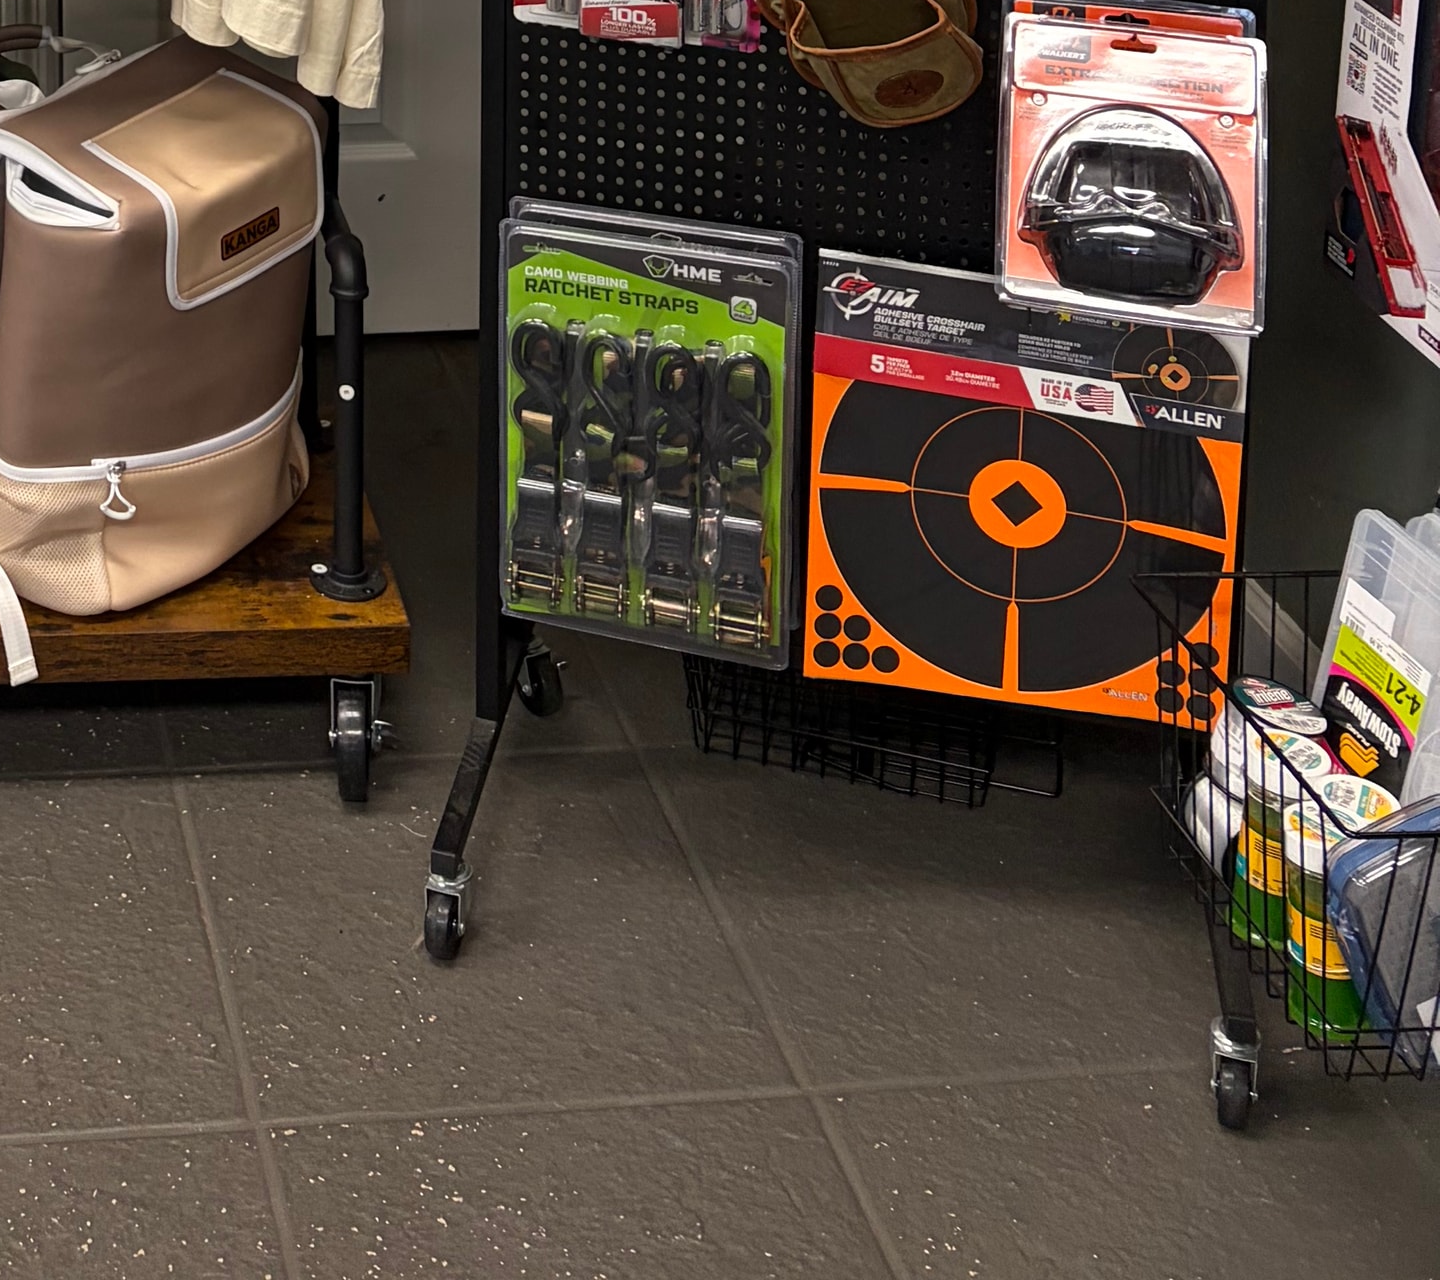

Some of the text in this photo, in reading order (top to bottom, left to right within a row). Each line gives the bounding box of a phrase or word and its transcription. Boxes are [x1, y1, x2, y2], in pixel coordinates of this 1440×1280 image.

[601, 19, 627, 27] LONGER
[609, 8, 656, 26] 100%
[1375, 11, 1397, 37] CLEANING
[1039, 48, 1086, 59] WALKER'S
[1352, 23, 1401, 71] ALL IN ONE.
[223, 213, 278, 255] KANGA
[525, 266, 628, 289] CAMO WEBBING
[673, 264, 721, 282] HME
[525, 278, 698, 314] RATCHET STRAPS
[839, 278, 920, 309] EZ AIM
[733, 300, 754, 315] 4
[873, 315, 965, 336] BULLSEYE TARGET
[874, 307, 986, 332] ADHESIVE CROSSHAIR
[1072, 315, 1107, 325] TECHNOLOGY
[873, 323, 973, 345] CIBLE ADHESIVE DE TYPE
[892, 333, 903, 341] DE
[905, 334, 932, 344] BOEUF
[870, 354, 884, 373] 5
[1040, 383, 1073, 401] USA
[1153, 406, 1222, 430] ALLEN
[1107, 689, 1148, 702] ALLEN
[1249, 688, 1293, 704] Trilene
[1386, 672, 1422, 716] 4-21
[1335, 681, 1401, 758] StowAway
